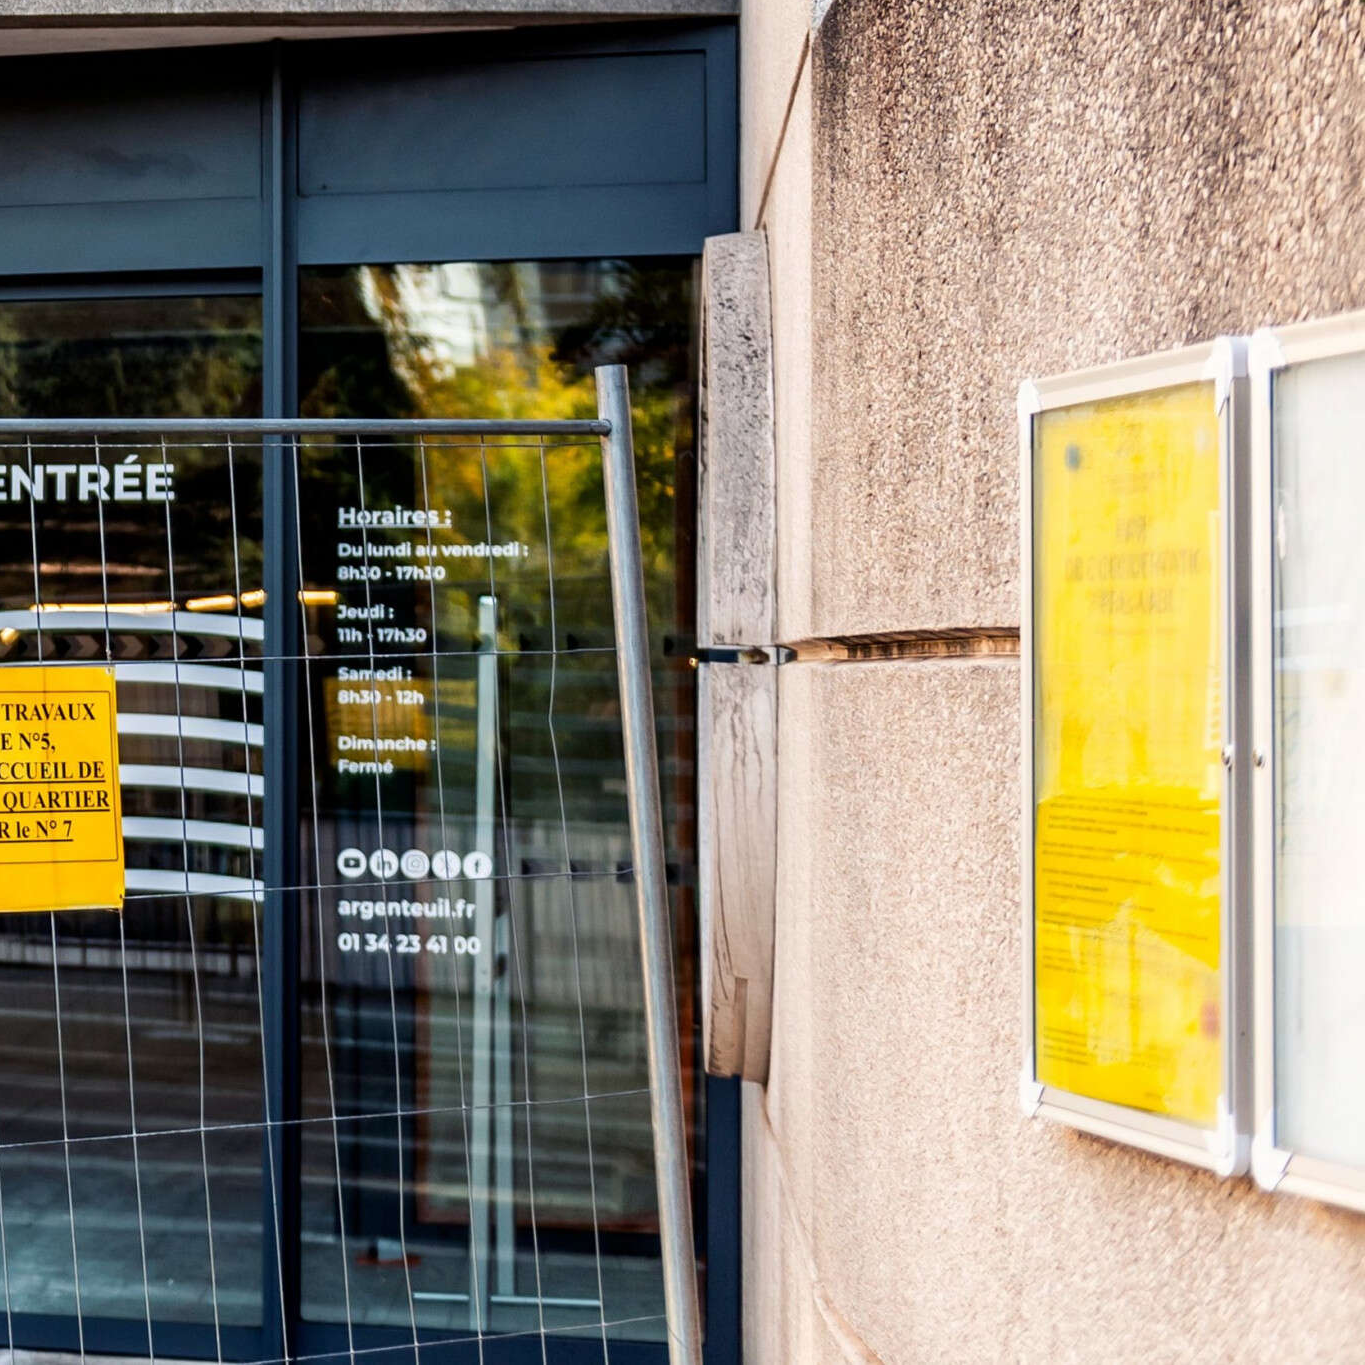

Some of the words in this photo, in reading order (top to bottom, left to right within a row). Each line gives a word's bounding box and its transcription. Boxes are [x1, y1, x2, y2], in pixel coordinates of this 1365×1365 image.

[337, 506, 440, 526] Horaires
[337, 542, 363, 558] Du
[367, 541, 411, 558] lundi
[415, 545, 437, 557] au
[440, 541, 519, 558] vendredi
[337, 565, 382, 581] 8h30
[395, 565, 446, 581] 17h30
[337, 604, 385, 619] Jeudi
[337, 628, 363, 643] 11h
[377, 628, 427, 643] 17h30
[337, 666, 405, 681] Samedi
[337, 690, 382, 705] 8h30
[396, 690, 425, 705] 12h
[1, 703, 96, 721] TRAVAUX
[337, 736, 428, 751] Dimanche
[79, 761, 106, 779] DE
[337, 758, 394, 774] Fermé
[3, 790, 110, 812] QUARTIER
[16, 821, 30, 839] le
[35, 820, 57, 839] N°
[63, 820, 73, 837] 7
[337, 898, 476, 921] argenteuil.fr
[337, 932, 360, 953] 01
[364, 933, 392, 953] 34
[395, 934, 422, 954] 23
[425, 935, 448, 954] 41
[453, 935, 482, 955] 00
